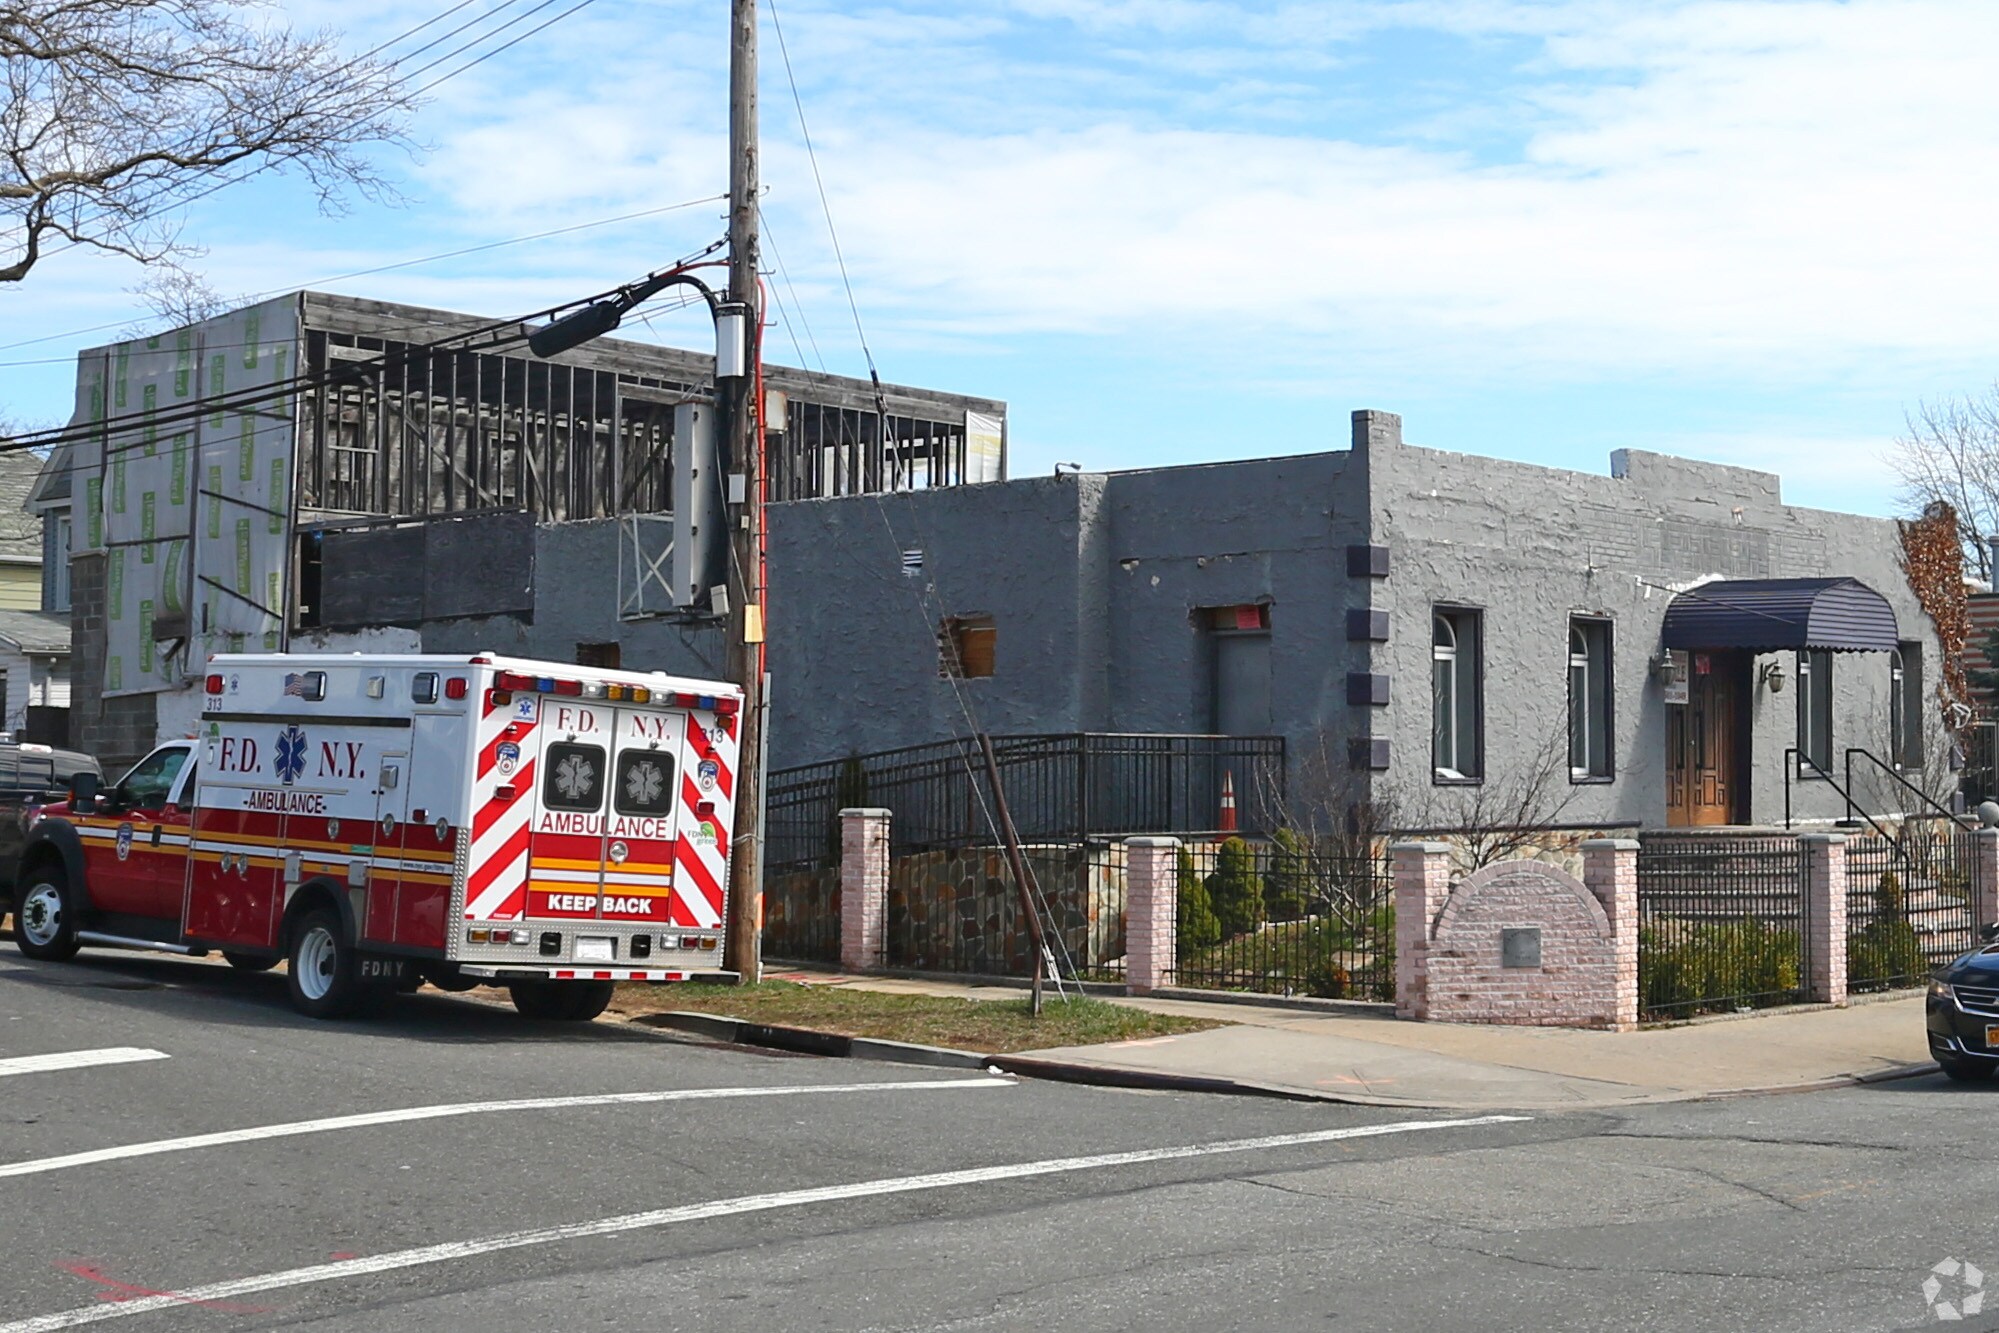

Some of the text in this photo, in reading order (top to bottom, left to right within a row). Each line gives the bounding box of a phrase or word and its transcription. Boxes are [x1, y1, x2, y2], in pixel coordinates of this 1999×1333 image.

[206, 697, 222, 711] 313
[557, 707, 671, 741] F.D. N.Y.
[700, 728, 724, 743] 313
[218, 737, 366, 779] F.D. N.Y.
[540, 812, 667, 838] AMBULANCE
[548, 894, 652, 914] KEEP BACK
[362, 960, 405, 977] FDNY
